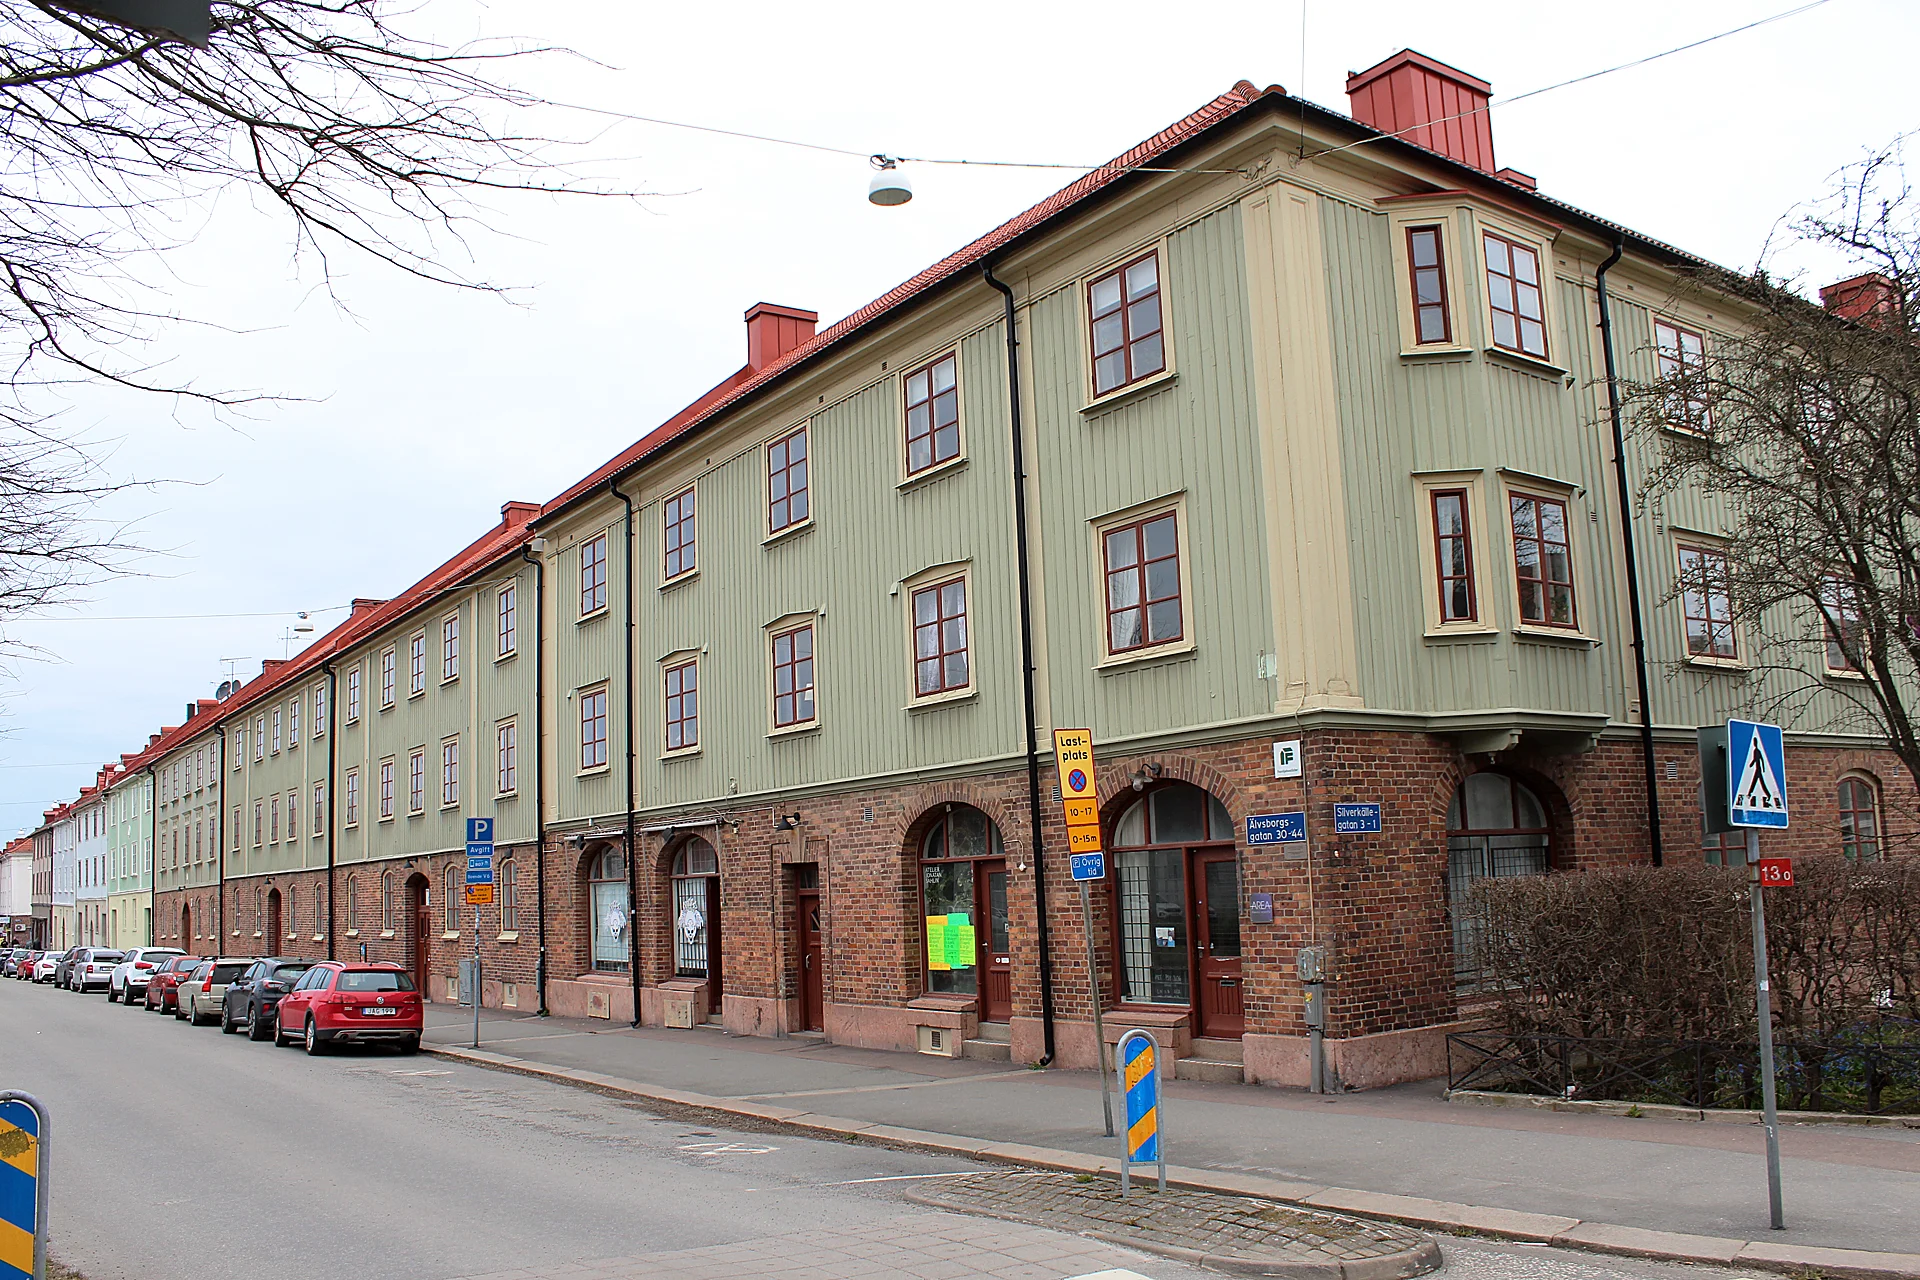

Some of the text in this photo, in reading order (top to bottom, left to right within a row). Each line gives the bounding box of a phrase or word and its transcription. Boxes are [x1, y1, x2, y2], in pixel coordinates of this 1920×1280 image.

[1060, 736, 1087, 746] Last-
[1062, 750, 1088, 763] plats
[1337, 807, 1378, 817] Silverkälle-
[1249, 818, 1294, 829] Älvsborgs-
[1337, 820, 1358, 831] gatan
[474, 820, 488, 840] P
[1249, 829, 1303, 843] gatan 30-44
[470, 846, 490, 854] Avgift
[1081, 855, 1100, 867] Övrig
[1087, 867, 1097, 876] tid
[1251, 900, 1271, 910] AREA
